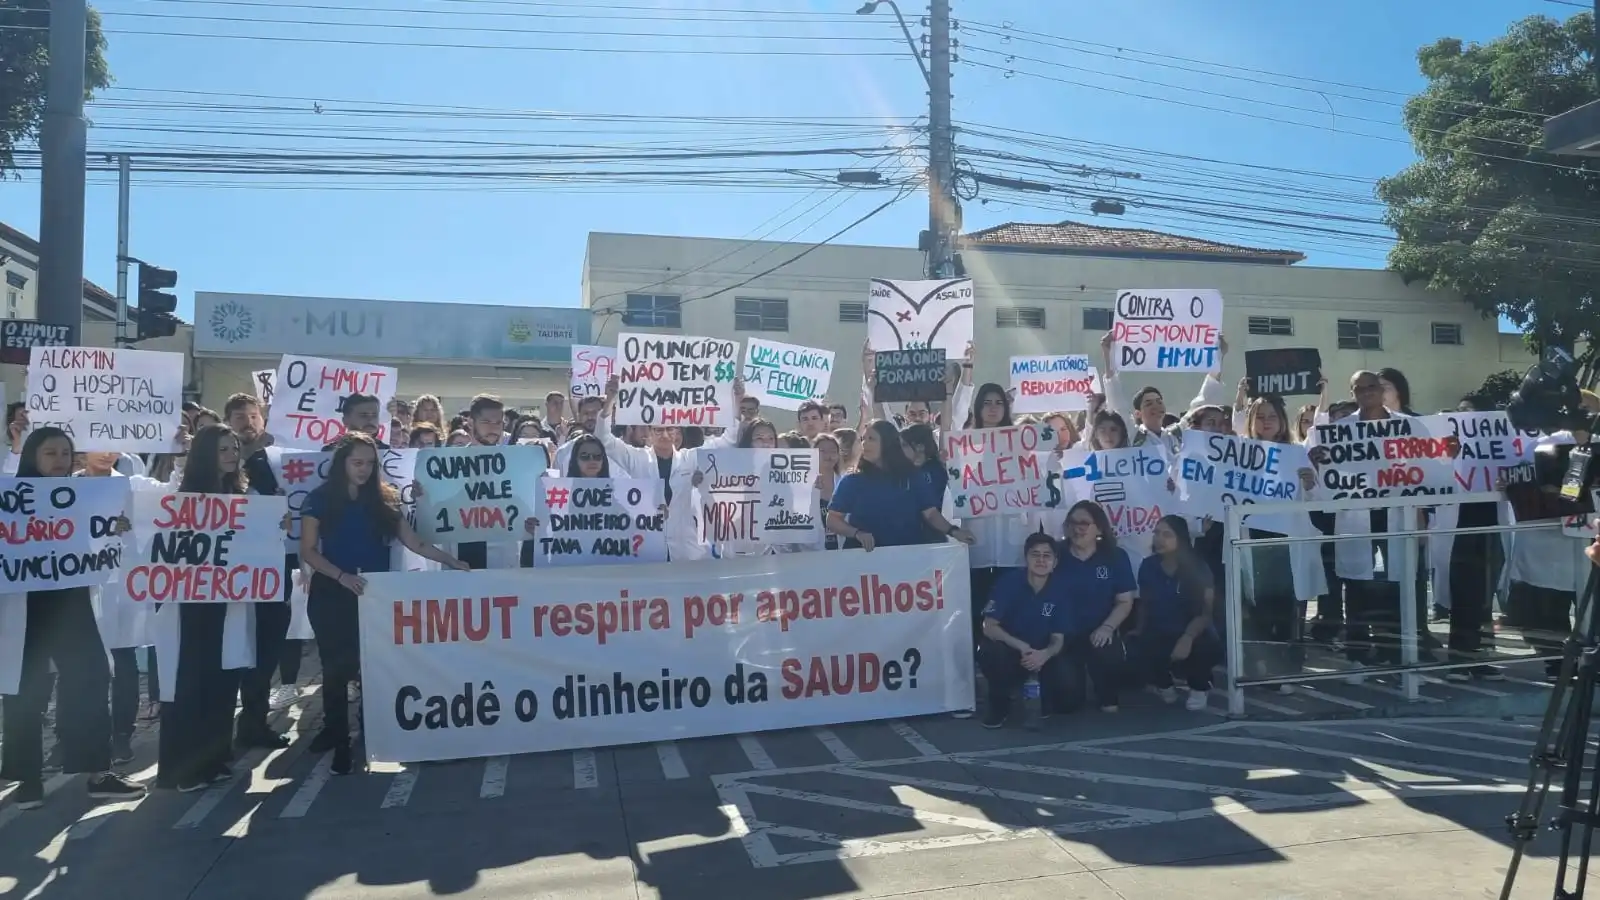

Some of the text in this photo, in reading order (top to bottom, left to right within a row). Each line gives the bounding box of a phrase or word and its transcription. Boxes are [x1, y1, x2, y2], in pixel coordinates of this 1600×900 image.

[936, 287, 972, 301] ASFALTO
[1117, 291, 1204, 319] CONTRA O
[5, 322, 70, 340] O HMUT
[1114, 321, 1219, 345] DESMONTE
[39, 349, 115, 370] ALCKMIN
[624, 336, 734, 363] O MUNICÍPIO
[750, 344, 780, 365] UMA
[876, 349, 945, 367] PARA ONDE
[1121, 345, 1219, 369] DO HMUT
[286, 360, 307, 389] O
[319, 365, 386, 394] HMUT
[620, 359, 736, 383] NÃO TEM $$
[743, 364, 764, 384] JÁ
[878, 366, 946, 384] FORAM OS
[1011, 356, 1088, 374] AMBULATÓRIOS
[43, 374, 164, 399] O HOSPITAL
[1257, 370, 1312, 394] HMUT
[30, 394, 175, 416] QUE TE FORMOU
[297, 387, 317, 412] É
[618, 385, 719, 408] P/ MANTER
[641, 404, 721, 425] O HMUT
[90, 422, 163, 442] FALINDO!
[947, 425, 1038, 460] MUITO
[1316, 419, 1412, 444] TEM TANTA
[1207, 435, 1282, 475] SAUDE
[1459, 438, 1524, 460] ALE 1
[426, 452, 506, 480] QUANTO
[770, 453, 811, 471] DE
[963, 451, 1041, 490] ALÉM
[1104, 449, 1167, 478] Leito
[1182, 457, 1215, 485] EM
[768, 470, 802, 484] POUCOS
[1324, 463, 1425, 490] QUE NÃO
[50, 486, 76, 510] O
[464, 479, 513, 501] VALE
[627, 487, 642, 506] O
[970, 491, 999, 516] DO
[1005, 484, 1042, 508] QUE
[153, 493, 249, 531] SAÚDE
[435, 507, 454, 533] 1
[459, 505, 519, 532] VIDA?
[550, 512, 664, 532] DINHEIRO QUE
[703, 499, 761, 543] MORTE
[764, 509, 814, 526] milhões
[150, 530, 236, 566] NÃO É
[539, 534, 644, 558] TAVA AQUI?
[393, 570, 944, 645] HMUT respira por aparelhos!
[395, 648, 921, 731] Cadê o dinheiro da SAUDe?
